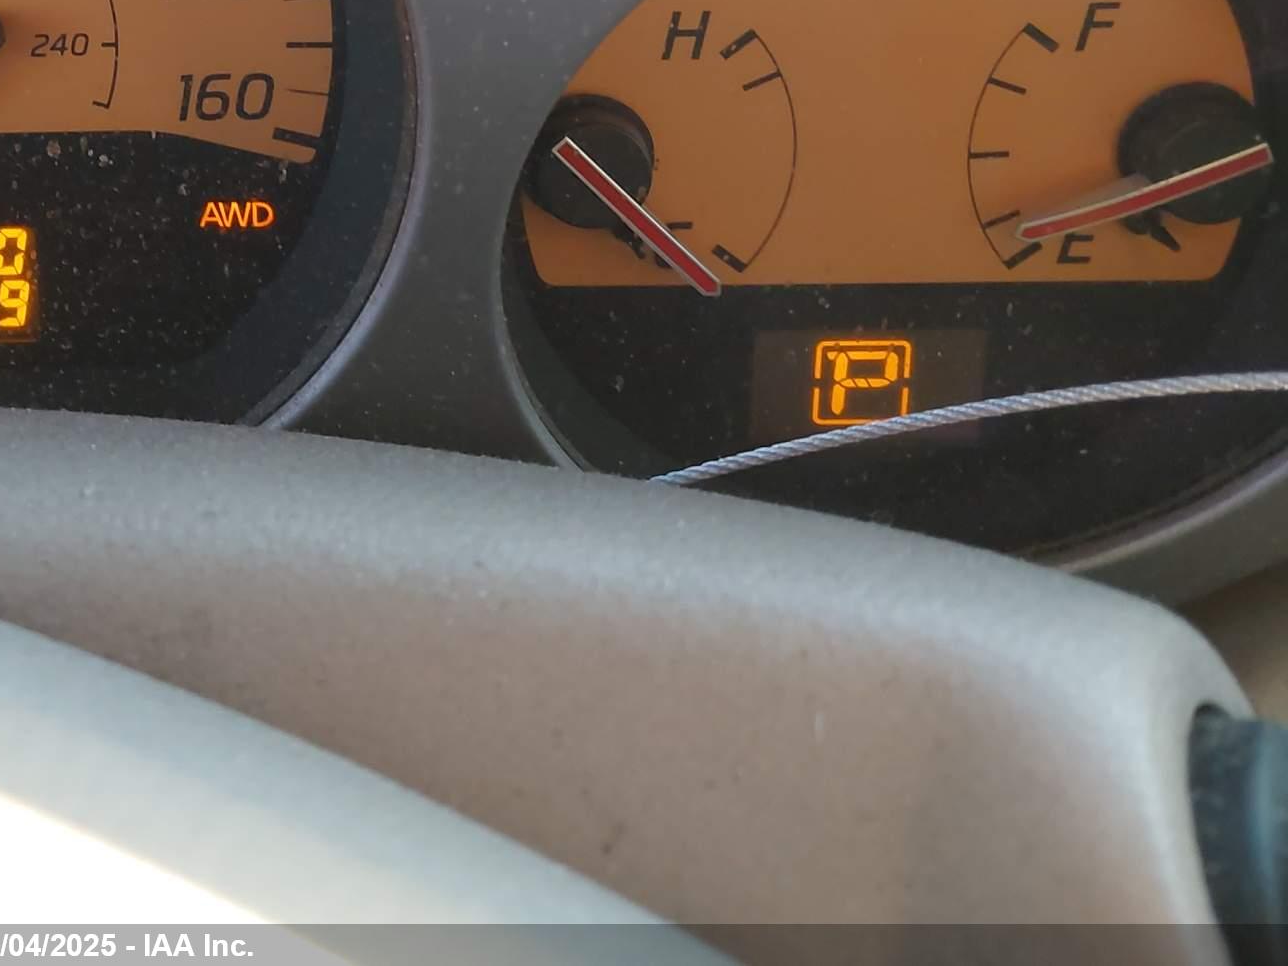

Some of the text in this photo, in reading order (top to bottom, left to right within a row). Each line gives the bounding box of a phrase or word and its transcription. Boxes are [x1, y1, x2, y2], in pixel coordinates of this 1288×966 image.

[29, 33, 90, 58] 240
[660, 10, 712, 62] H
[1074, 1, 1121, 52] F
[178, 72, 276, 123] 160
[198, 200, 275, 229] AWD
[829, 349, 899, 417] P
